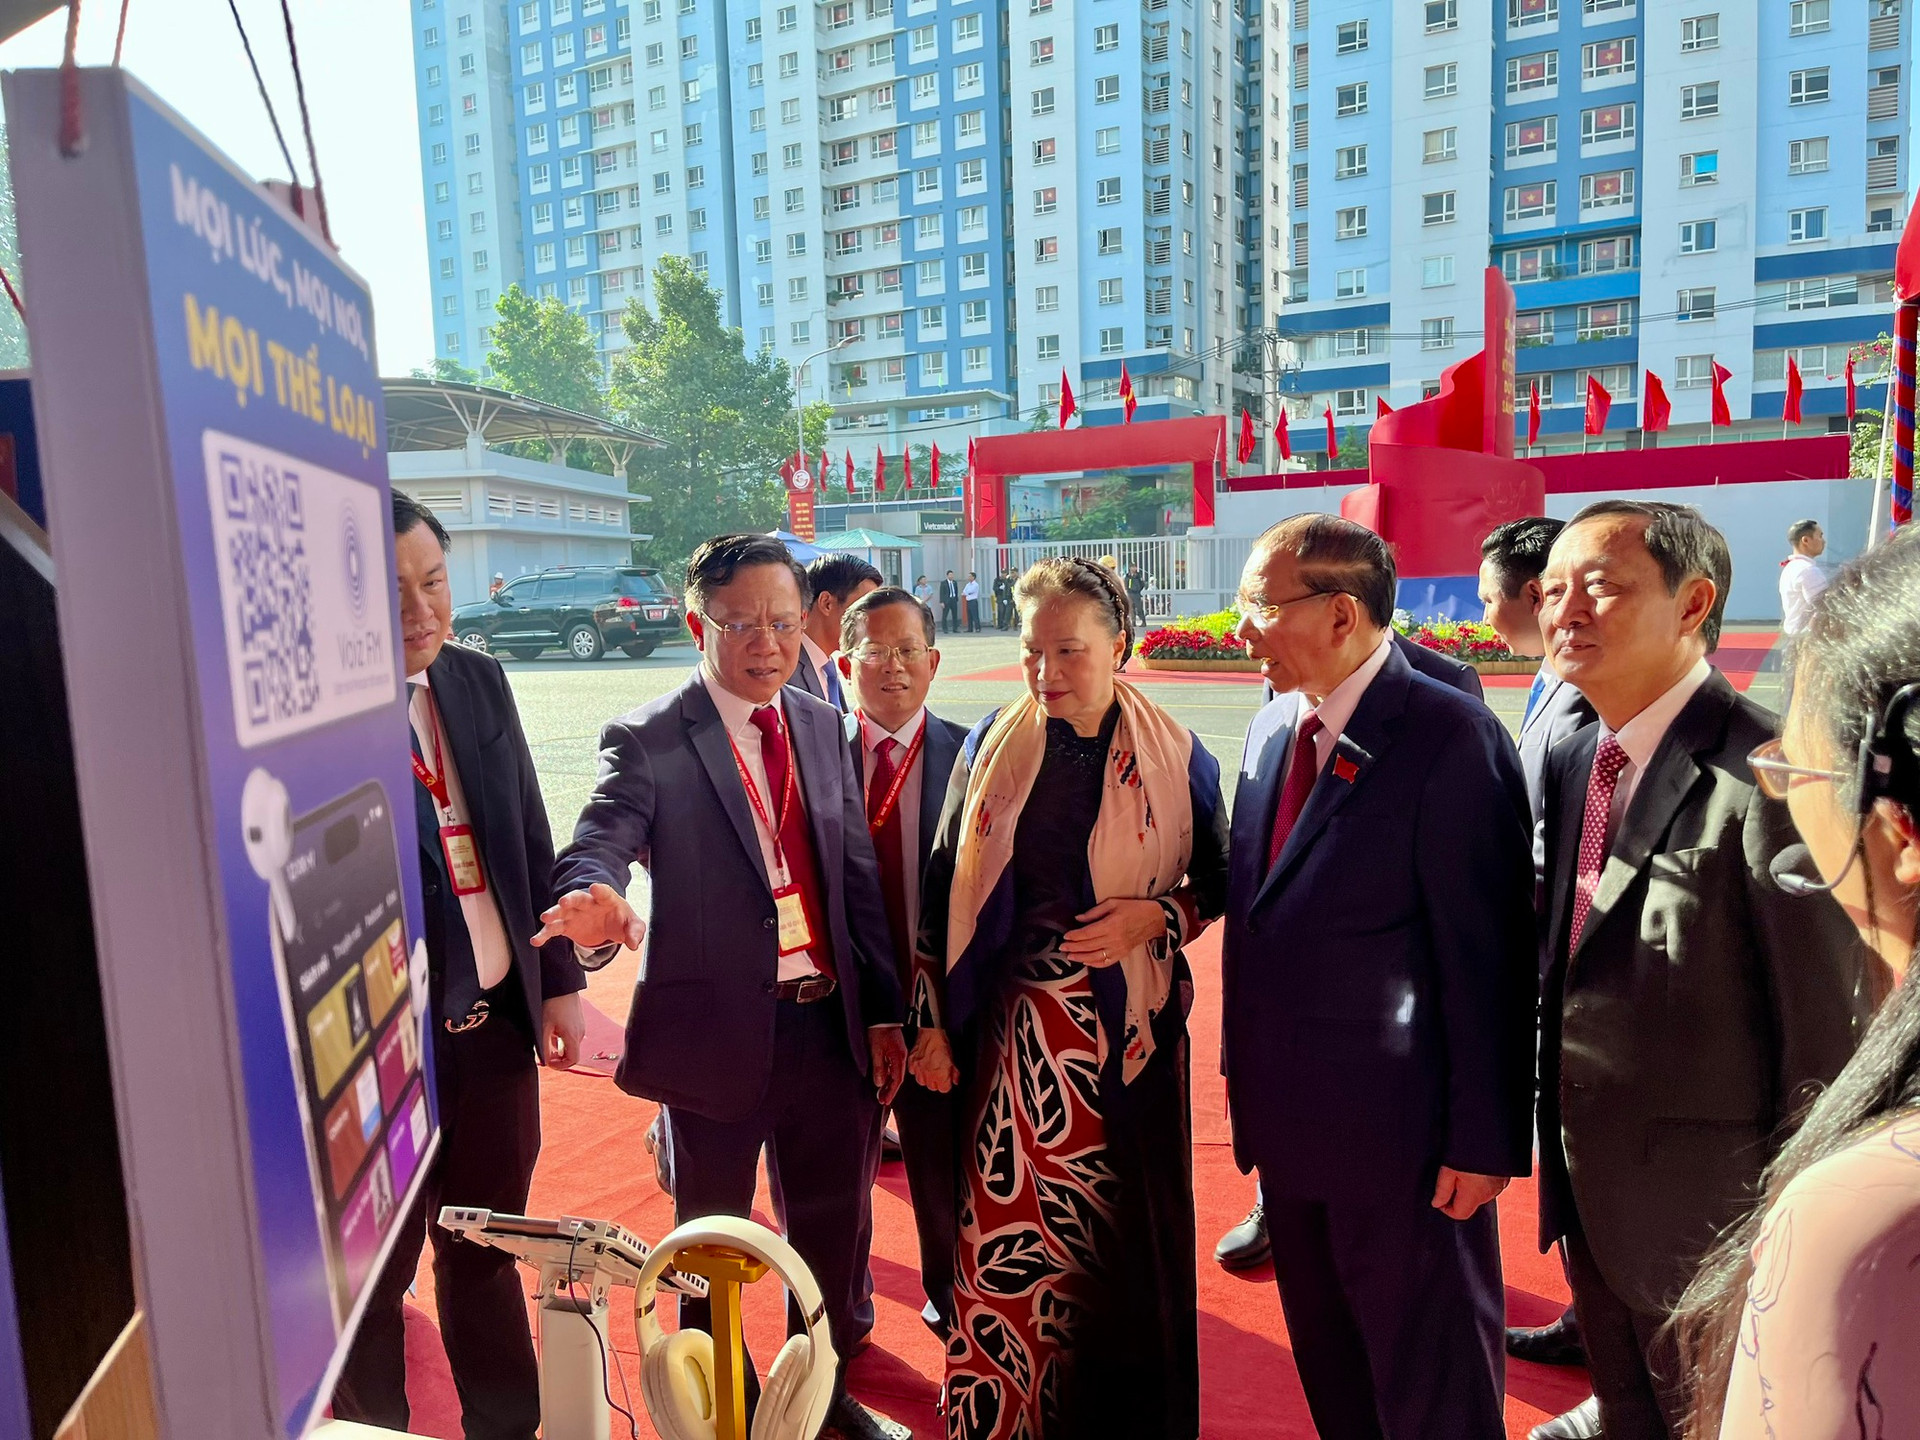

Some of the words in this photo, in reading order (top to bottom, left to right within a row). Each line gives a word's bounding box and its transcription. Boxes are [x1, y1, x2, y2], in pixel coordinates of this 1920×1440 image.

[170, 163, 234, 263] MỌI
[236, 217, 293, 308] LÚC,
[293, 259, 331, 334] MỌI
[184, 293, 265, 408] MỌI
[328, 375, 377, 458] LOẠI
[923, 521, 956, 530] Vietcombank
